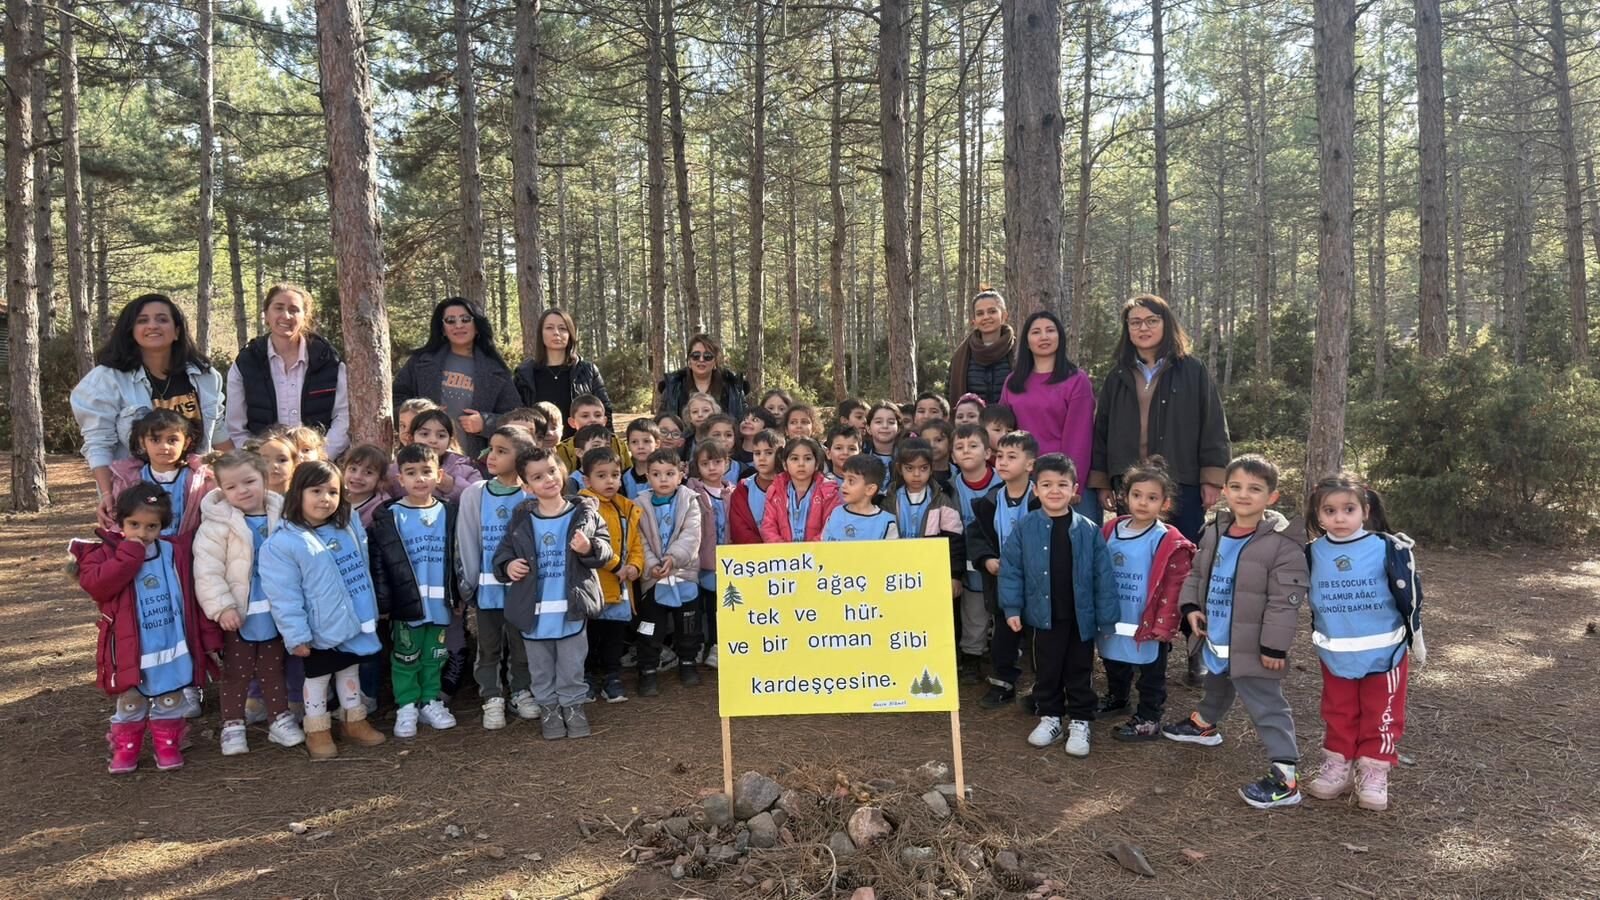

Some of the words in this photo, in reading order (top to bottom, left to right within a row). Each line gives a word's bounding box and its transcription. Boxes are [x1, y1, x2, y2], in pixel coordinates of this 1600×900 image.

[721, 554, 824, 577] Yaşamak,
[768, 579, 795, 596] bir
[817, 575, 867, 595] ağaç
[885, 572, 922, 592] gibi
[1331, 580, 1340, 588] ES
[1341, 578, 1367, 588] ÇOCUK
[1355, 589, 1377, 599] AĞACI
[143, 605, 168, 618] LAMUR
[748, 609, 779, 625] tek
[795, 609, 817, 622] ve
[845, 604, 884, 621] hür.
[1348, 602, 1371, 612] BAKIM
[728, 641, 749, 654] ve
[762, 635, 788, 653] bir
[808, 633, 872, 648] orman
[890, 630, 928, 649] gibi
[751, 672, 897, 694] kardeşçesine.
